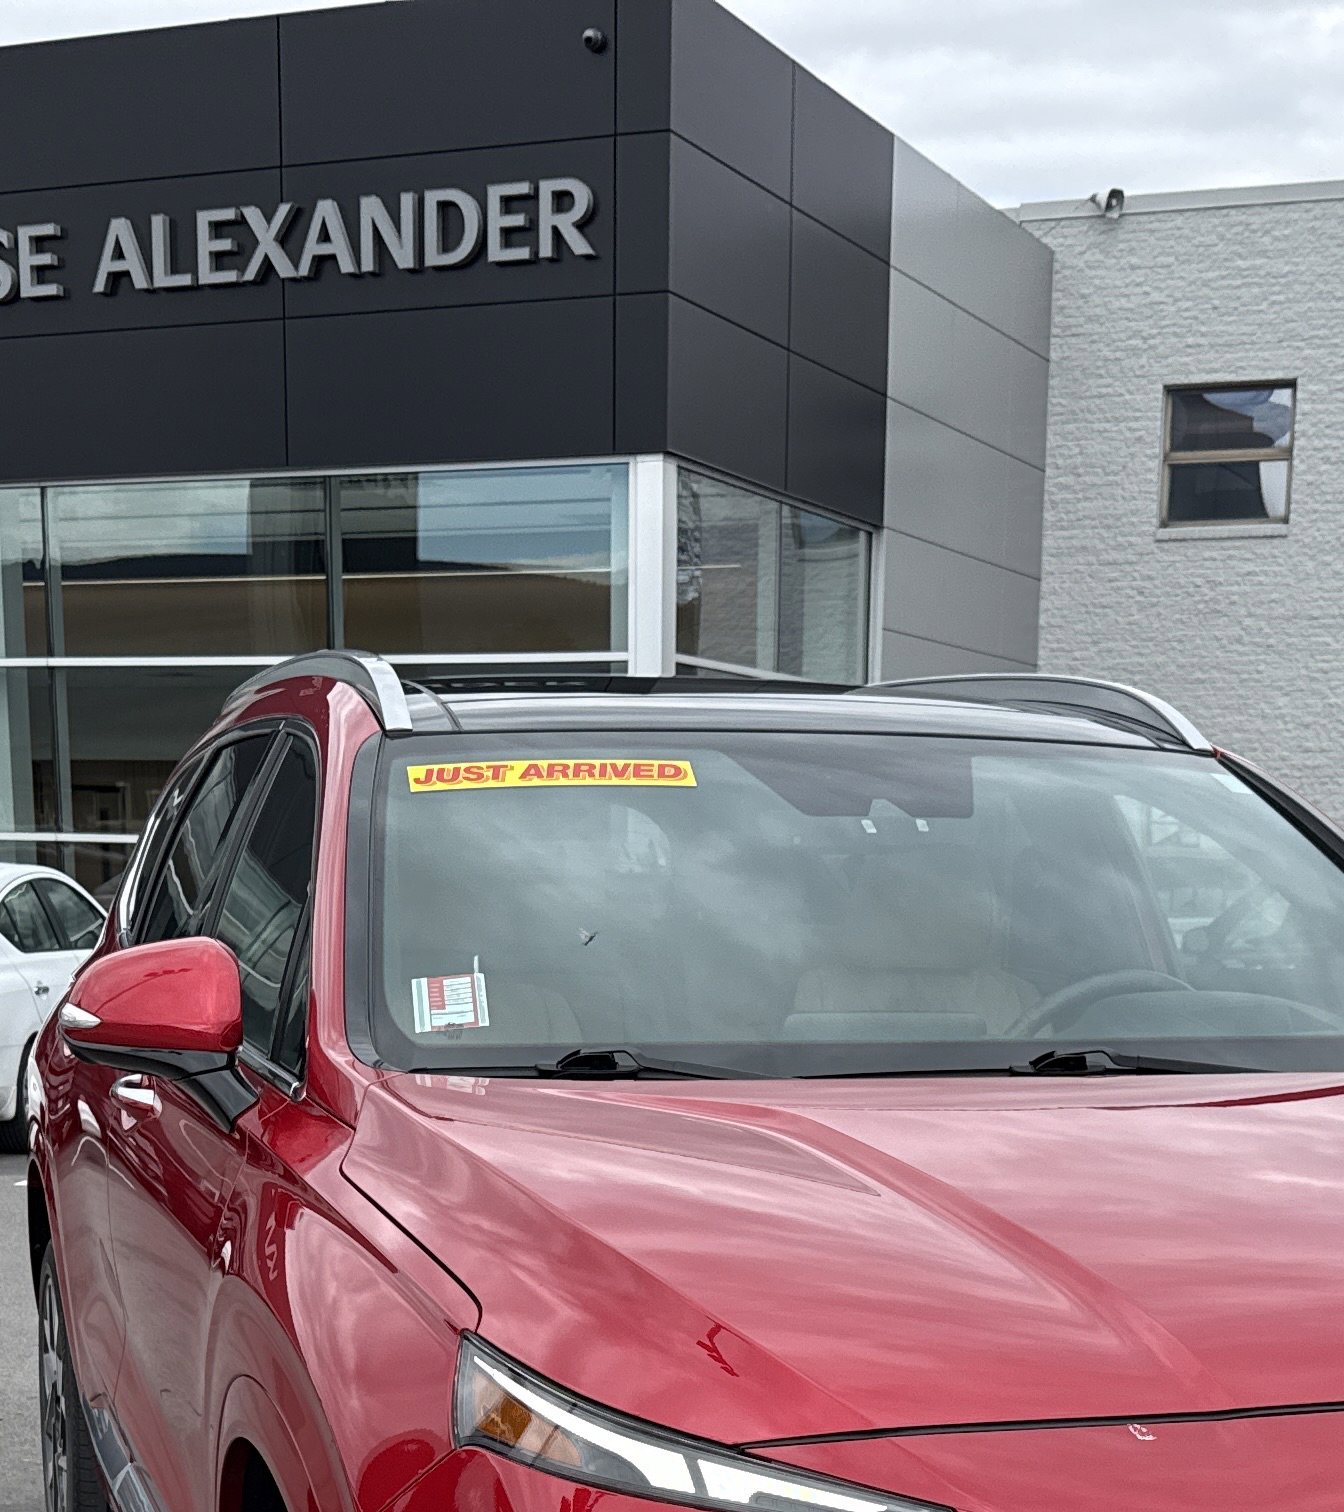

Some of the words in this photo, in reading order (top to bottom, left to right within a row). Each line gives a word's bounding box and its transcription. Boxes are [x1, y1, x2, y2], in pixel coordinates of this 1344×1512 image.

[92, 176, 598, 294] ALEXANDER
[413, 764, 514, 786] JUST
[518, 763, 689, 780] ARRIVED
